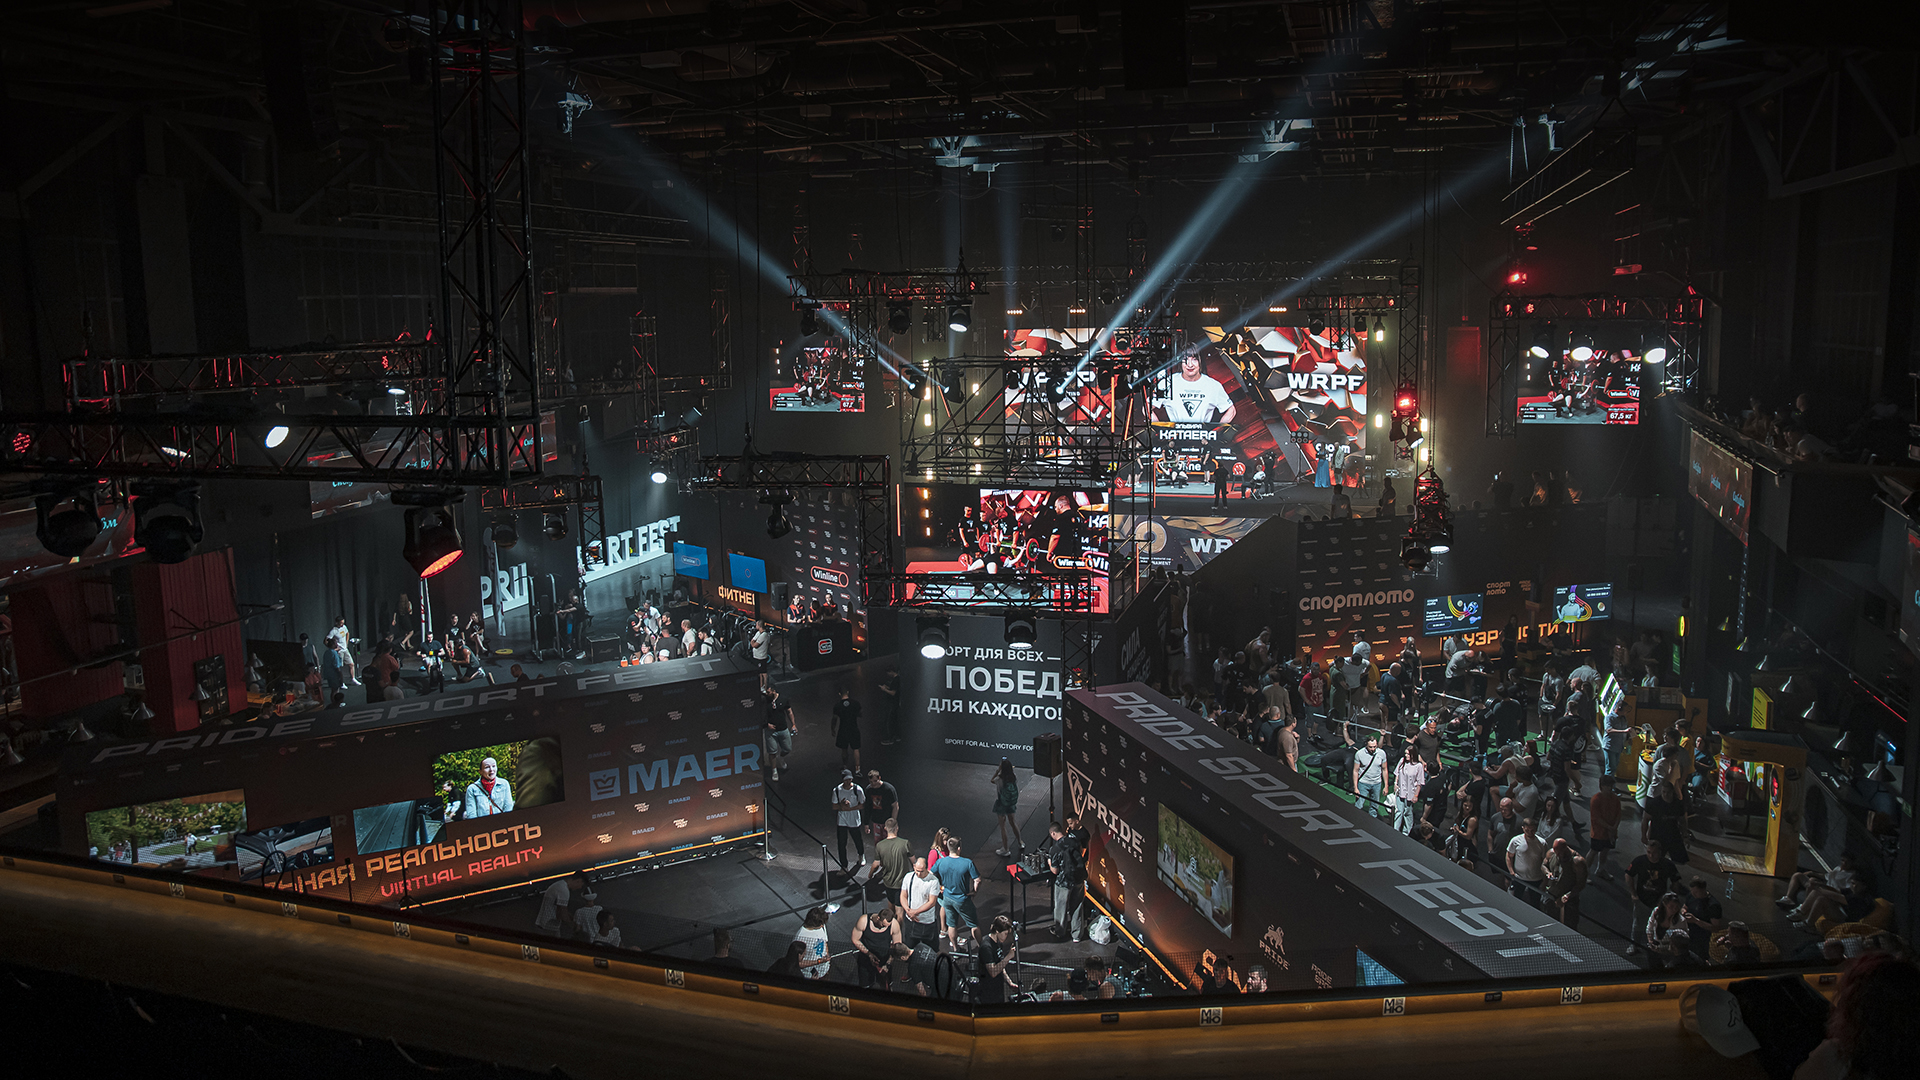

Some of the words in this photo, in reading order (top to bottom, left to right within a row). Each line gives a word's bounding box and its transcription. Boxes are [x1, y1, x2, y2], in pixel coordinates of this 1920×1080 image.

[1287, 373, 1364, 391] WRPF
[813, 568, 838, 583] Winline
[974, 647, 1003, 660] ДЛЯ
[1007, 650, 1044, 662] ВСЕХ
[946, 665, 1062, 700] ПОБЕД
[91, 717, 317, 764] PRIDE
[340, 682, 558, 725] SPORT
[577, 658, 723, 691] FEST
[927, 697, 963, 714] ДЛЯ
[968, 701, 1062, 720] КАЖДОГО!
[965, 739, 978, 747] FOR
[628, 743, 761, 795] MAER
[1086, 792, 1143, 854] PRIDE
[1095, 691, 1224, 751] PRIDE
[1198, 757, 1393, 850] SPORT
[1358, 858, 1584, 963] FEST
[366, 823, 542, 878] РЕАЛЬНОСТЬ
[1107, 829, 1143, 863] FITNESS
[380, 868, 462, 897] VIRTUAL
[468, 846, 543, 876] REALITY
[1259, 939, 1291, 971] PRIDE
[1311, 963, 1333, 985] PRIDE
